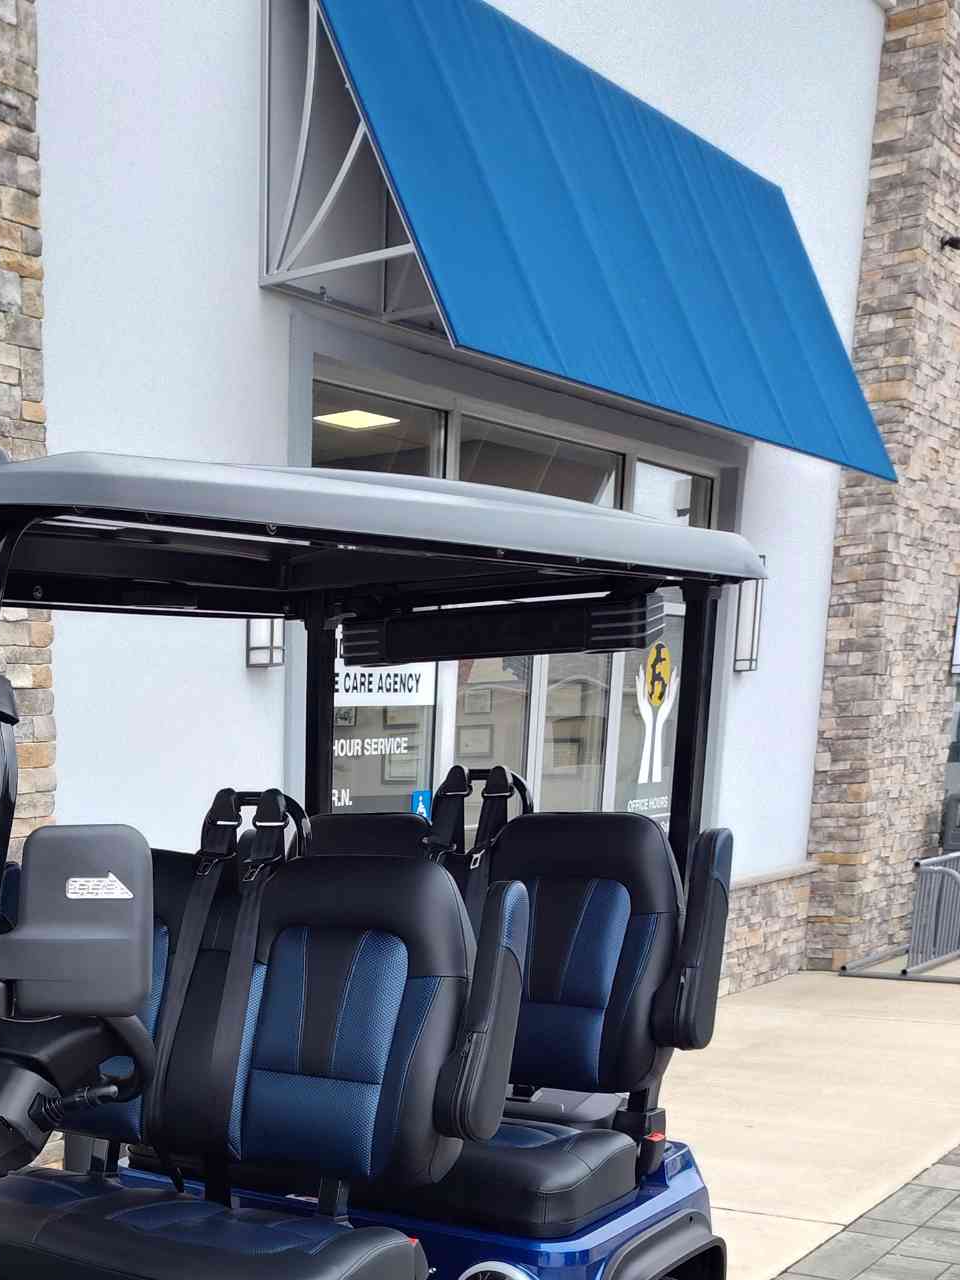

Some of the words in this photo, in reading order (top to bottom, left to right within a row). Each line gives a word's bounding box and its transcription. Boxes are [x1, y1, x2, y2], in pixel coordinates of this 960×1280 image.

[344, 673, 373, 693] CARE
[377, 673, 421, 693] AGENCY
[333, 738, 362, 756] HOUR
[364, 737, 408, 755] SERVICE
[627, 798, 648, 812] OFFICE
[649, 796, 668, 809] HOURS
